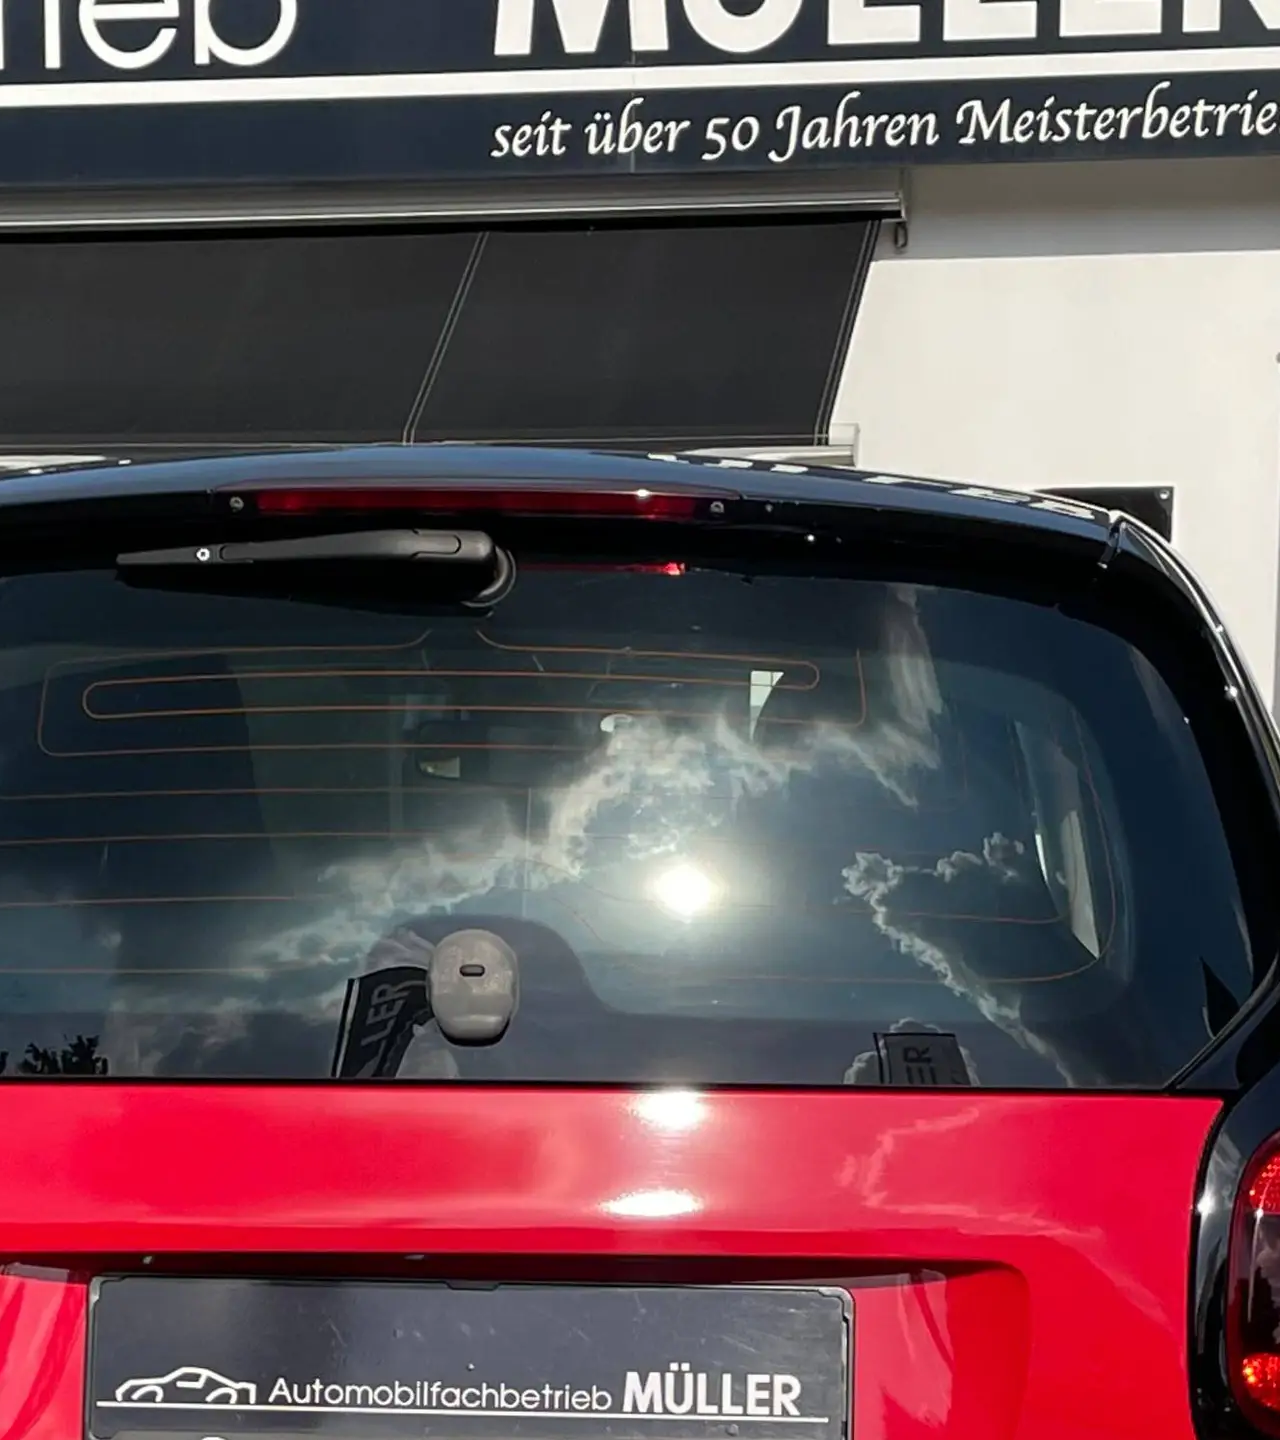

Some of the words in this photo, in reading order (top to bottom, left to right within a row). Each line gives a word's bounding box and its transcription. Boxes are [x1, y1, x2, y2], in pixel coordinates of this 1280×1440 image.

[491, 110, 572, 158] seit
[585, 97, 691, 155] über
[701, 116, 760, 161] 50
[768, 91, 939, 163] Jahren
[268, 1377, 613, 1411] Automobilfachbetrieb
[622, 1362, 801, 1416] MÜLLER
